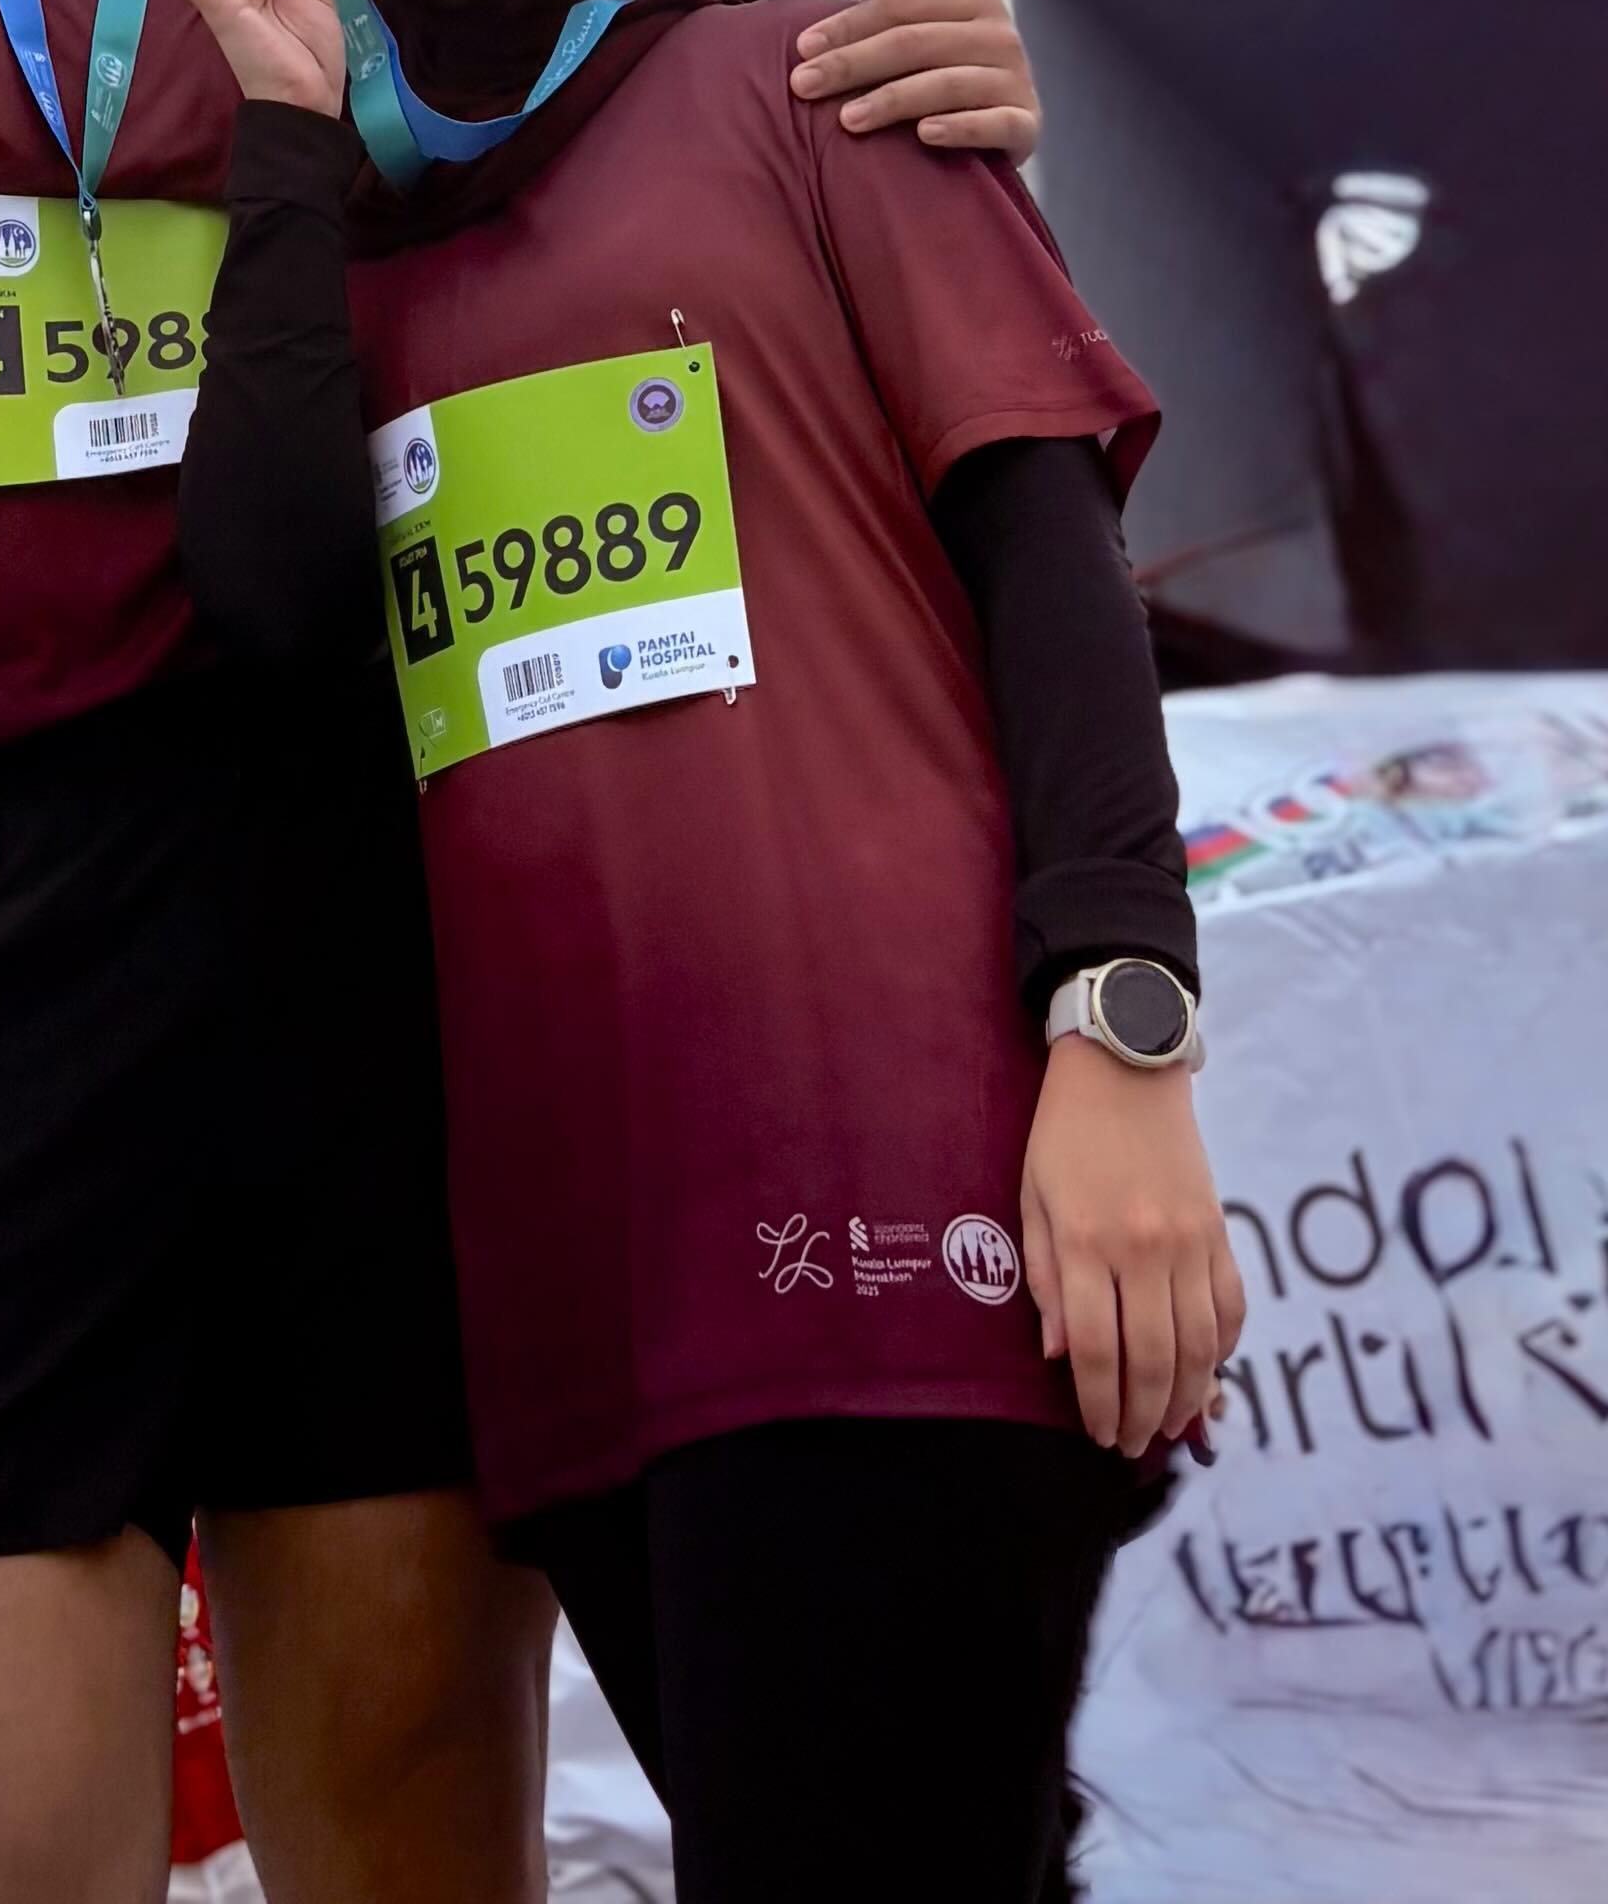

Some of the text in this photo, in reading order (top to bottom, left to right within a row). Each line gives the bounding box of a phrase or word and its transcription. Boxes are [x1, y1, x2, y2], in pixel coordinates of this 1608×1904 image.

[45, 311, 211, 383] 598
[455, 492, 701, 624] 59889
[412, 569, 438, 639] 4
[638, 630, 695, 653] PANTAI
[640, 642, 716, 669] HOSPITAL
